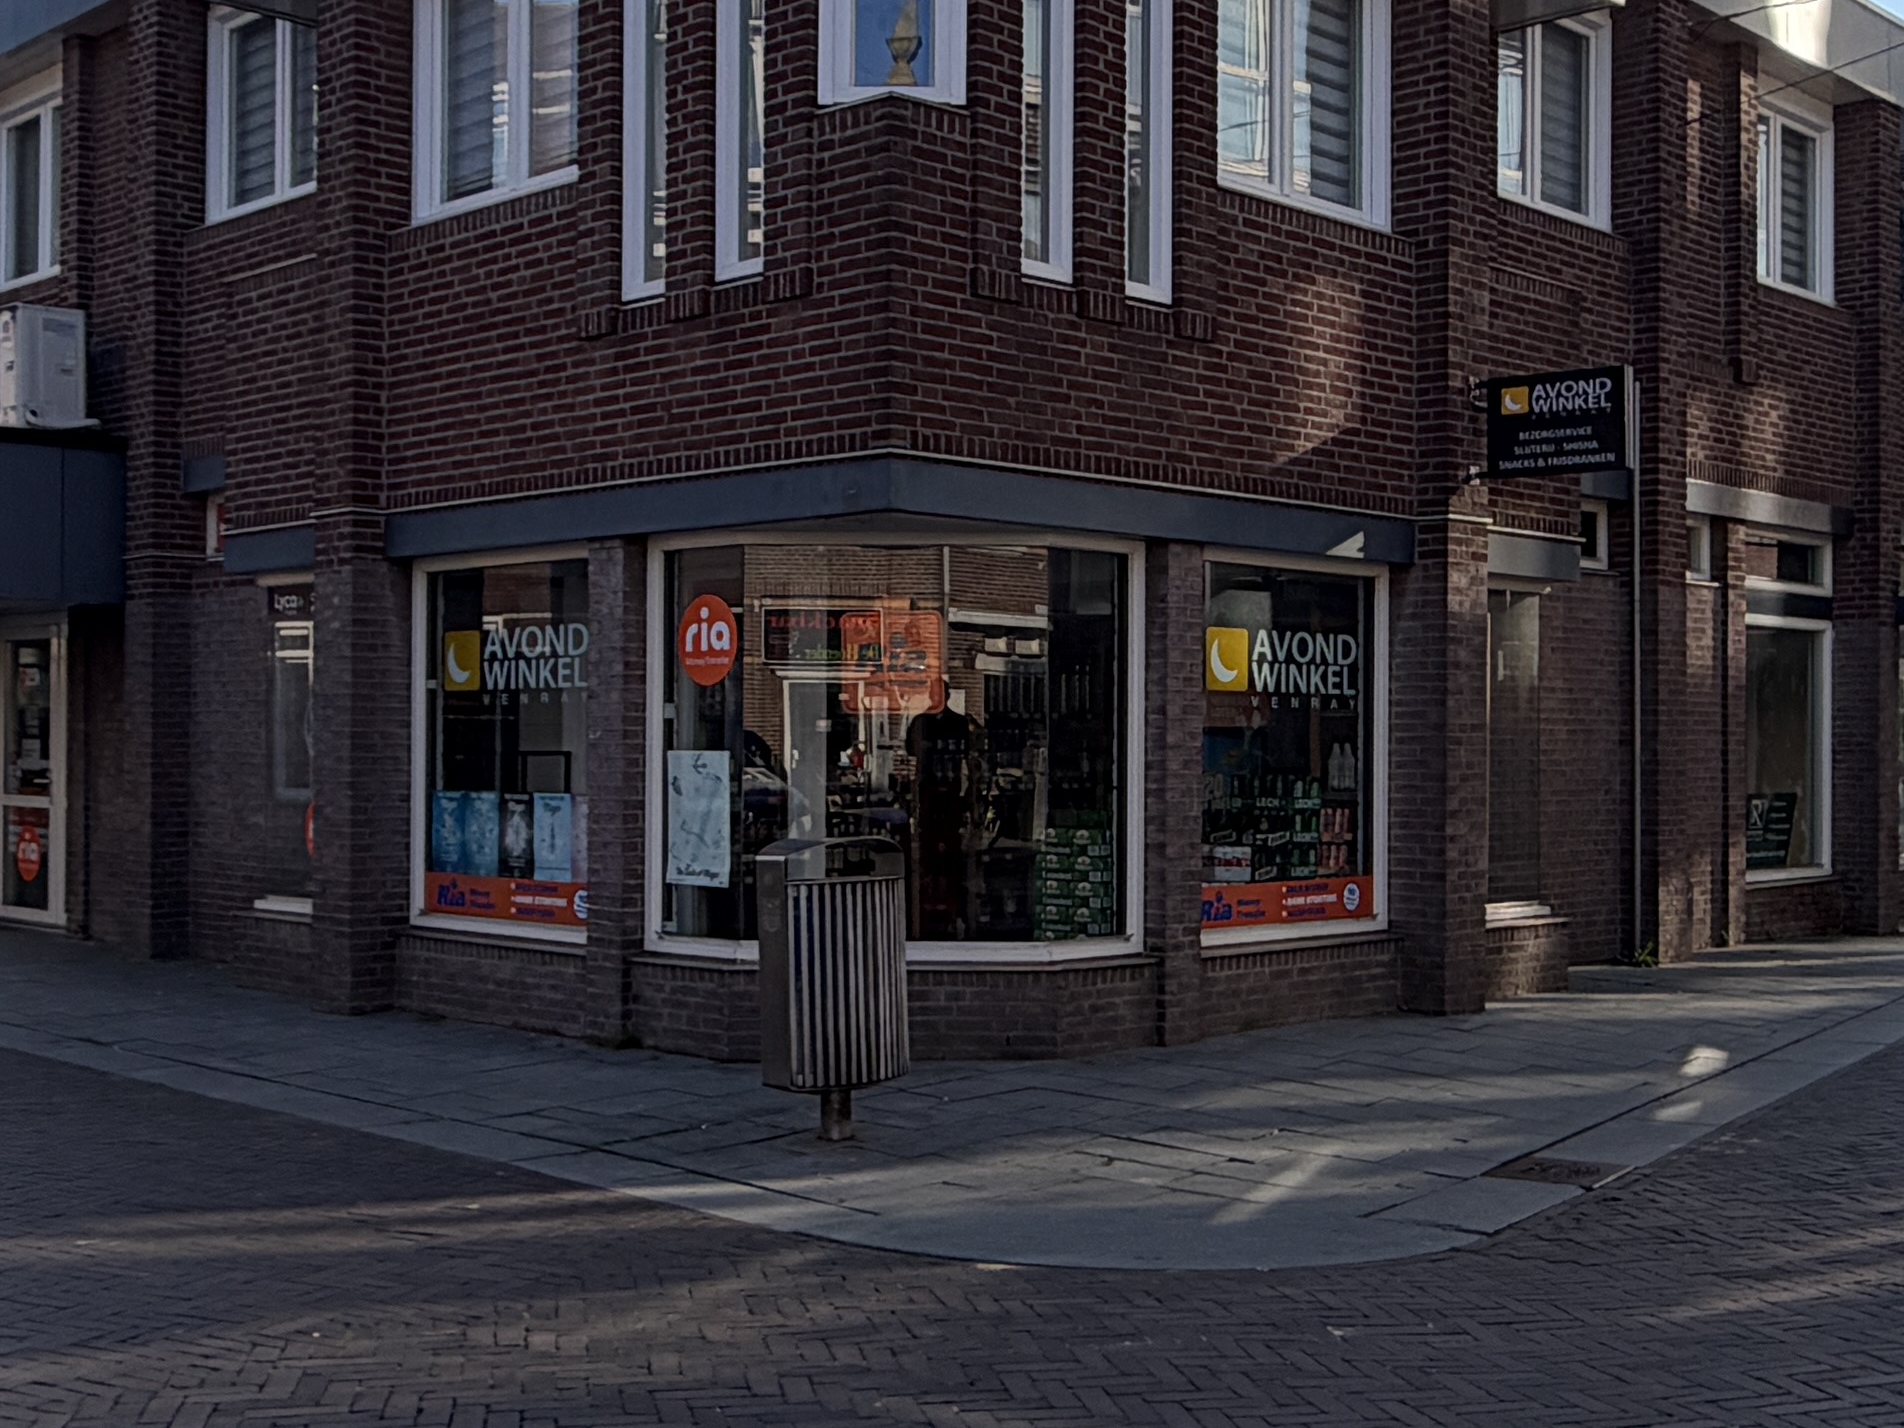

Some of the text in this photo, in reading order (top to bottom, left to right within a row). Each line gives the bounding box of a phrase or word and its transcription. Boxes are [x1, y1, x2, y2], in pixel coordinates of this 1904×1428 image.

[1531, 377, 1613, 399] AVOND
[1532, 392, 1612, 414] WINKEL
[482, 622, 590, 660] AVOND
[685, 606, 731, 653] ria
[1251, 628, 1358, 665] AVOND
[482, 656, 589, 691] WINKEL
[1251, 661, 1358, 696] WINKEL
[481, 691, 589, 706] VENRAY
[1250, 694, 1357, 710] VENRAY
